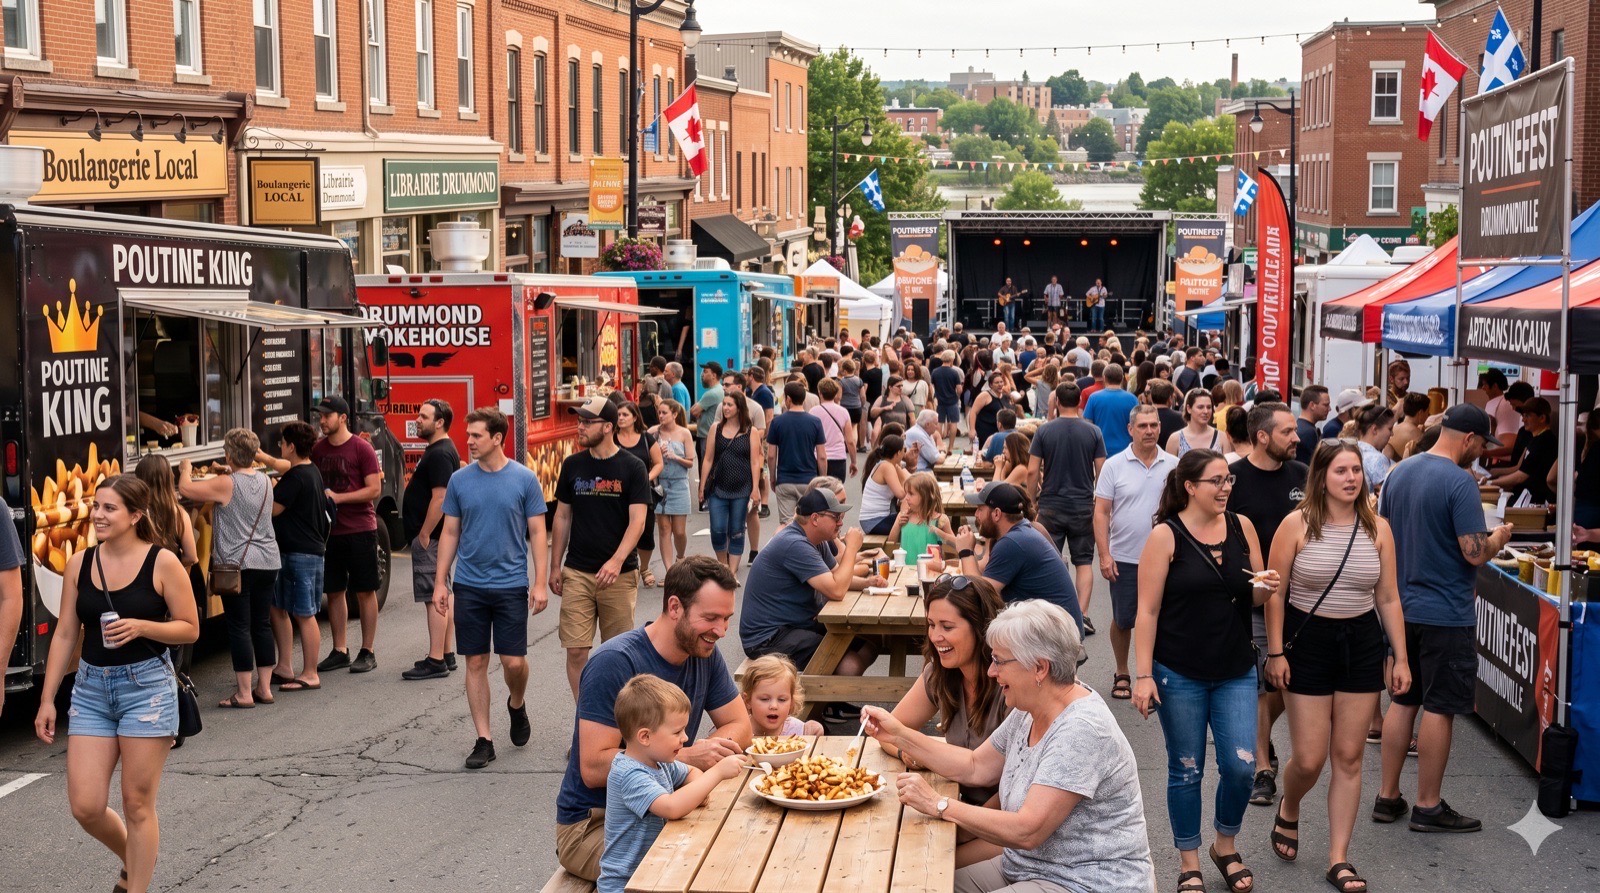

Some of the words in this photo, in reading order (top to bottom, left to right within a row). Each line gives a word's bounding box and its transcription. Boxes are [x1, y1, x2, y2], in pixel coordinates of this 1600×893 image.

[1469, 105, 1558, 184] POUTINEFEST
[43, 148, 150, 189] Boulangerie
[154, 149, 198, 179] Local
[323, 173, 354, 188] Librairie
[257, 180, 311, 190] Boulangerie
[264, 192, 304, 202] LOCAL
[323, 191, 355, 203] Drummond
[390, 173, 440, 197] LIBRAIRIE
[442, 171, 496, 195] DRUMMOND
[892, 226, 938, 234] POUTINEFEST
[1177, 227, 1224, 236] POUTINEFEST
[1480, 199, 1538, 236] DRUMMONDVILLE
[112, 244, 205, 284] POUTINE
[209, 249, 253, 286] KING
[363, 327, 491, 346] MOKEHOUSE
[1467, 317, 1508, 350] ARTISANS
[1509, 319, 1551, 356] LOCAUX
[41, 357, 110, 387] POUTINE
[42, 386, 111, 438] KING
[1475, 595, 1537, 684] OUTINEFEST
[1476, 652, 1524, 714] RUMMONDVILLE
